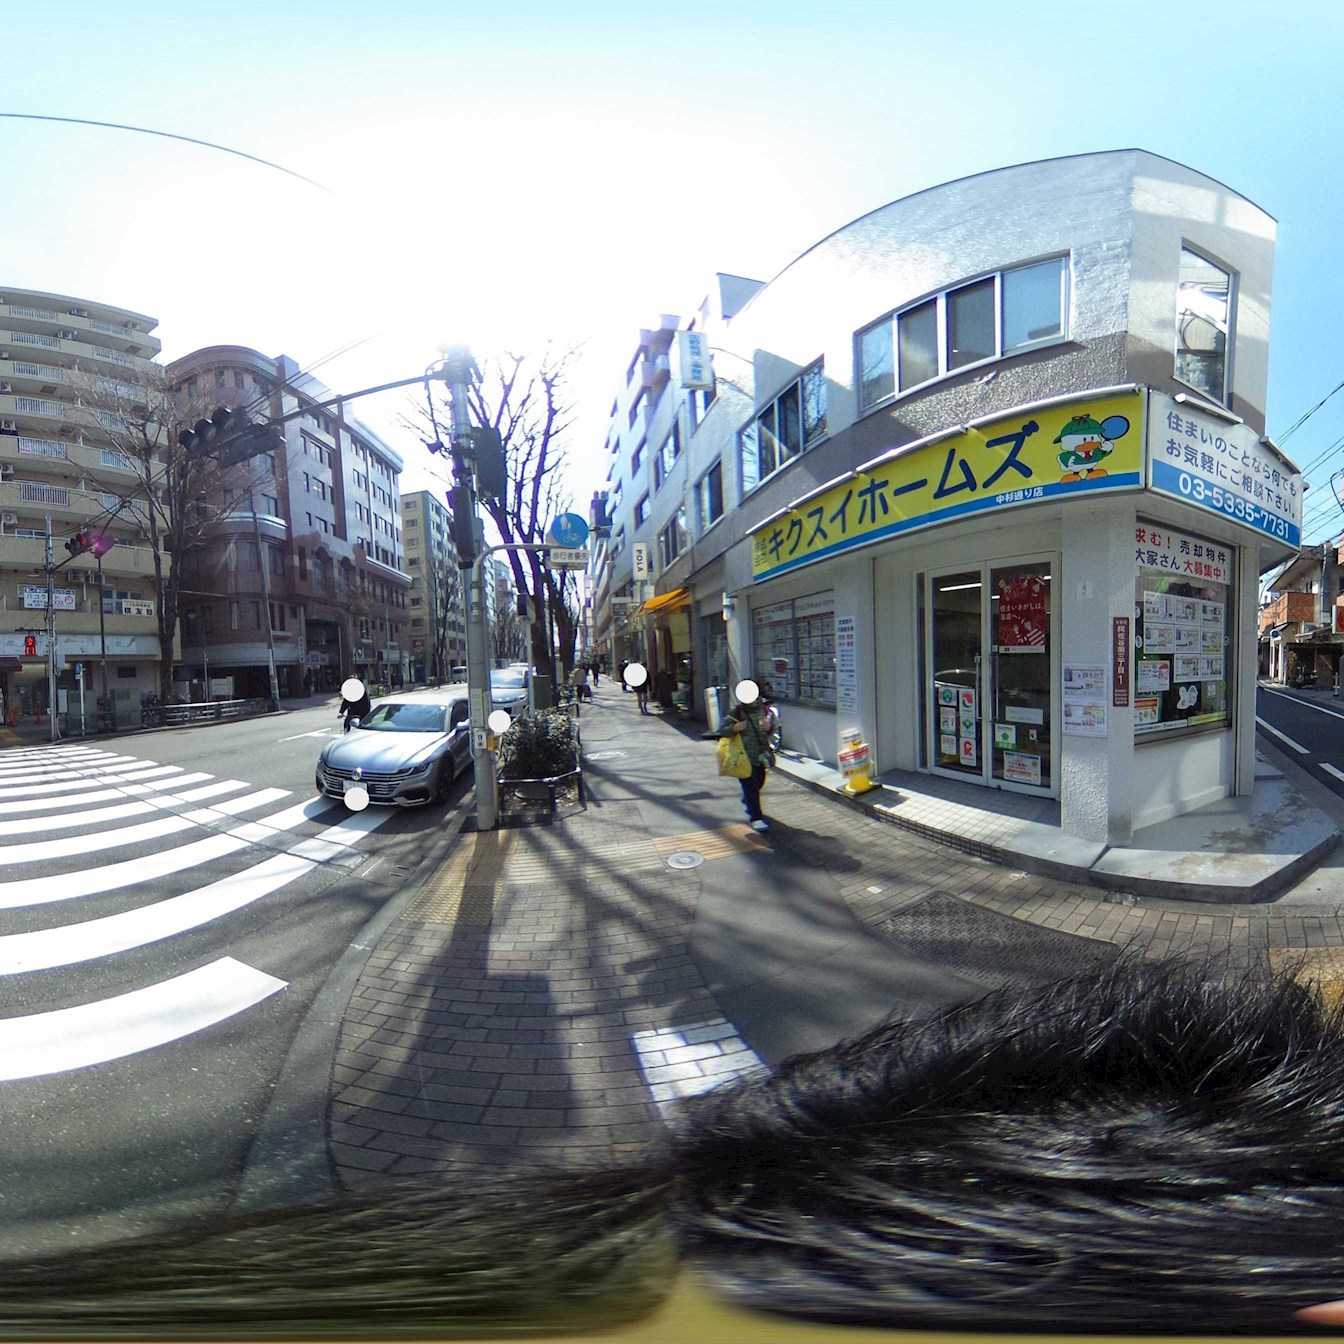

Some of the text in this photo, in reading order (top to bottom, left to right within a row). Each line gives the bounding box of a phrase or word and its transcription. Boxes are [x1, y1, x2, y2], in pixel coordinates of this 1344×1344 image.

[1165, 438, 1296, 519] お気軽にご相談下さい。
[1166, 410, 1297, 498] 住まいのことなら何でも
[768, 420, 1040, 561] キクスイホームズ
[995, 486, 1044, 504] 中杉通り店
[1178, 472, 1290, 539] 03-5335-7731
[1136, 547, 1181, 571] 大家さん
[1179, 540, 1227, 564] 売却物件
